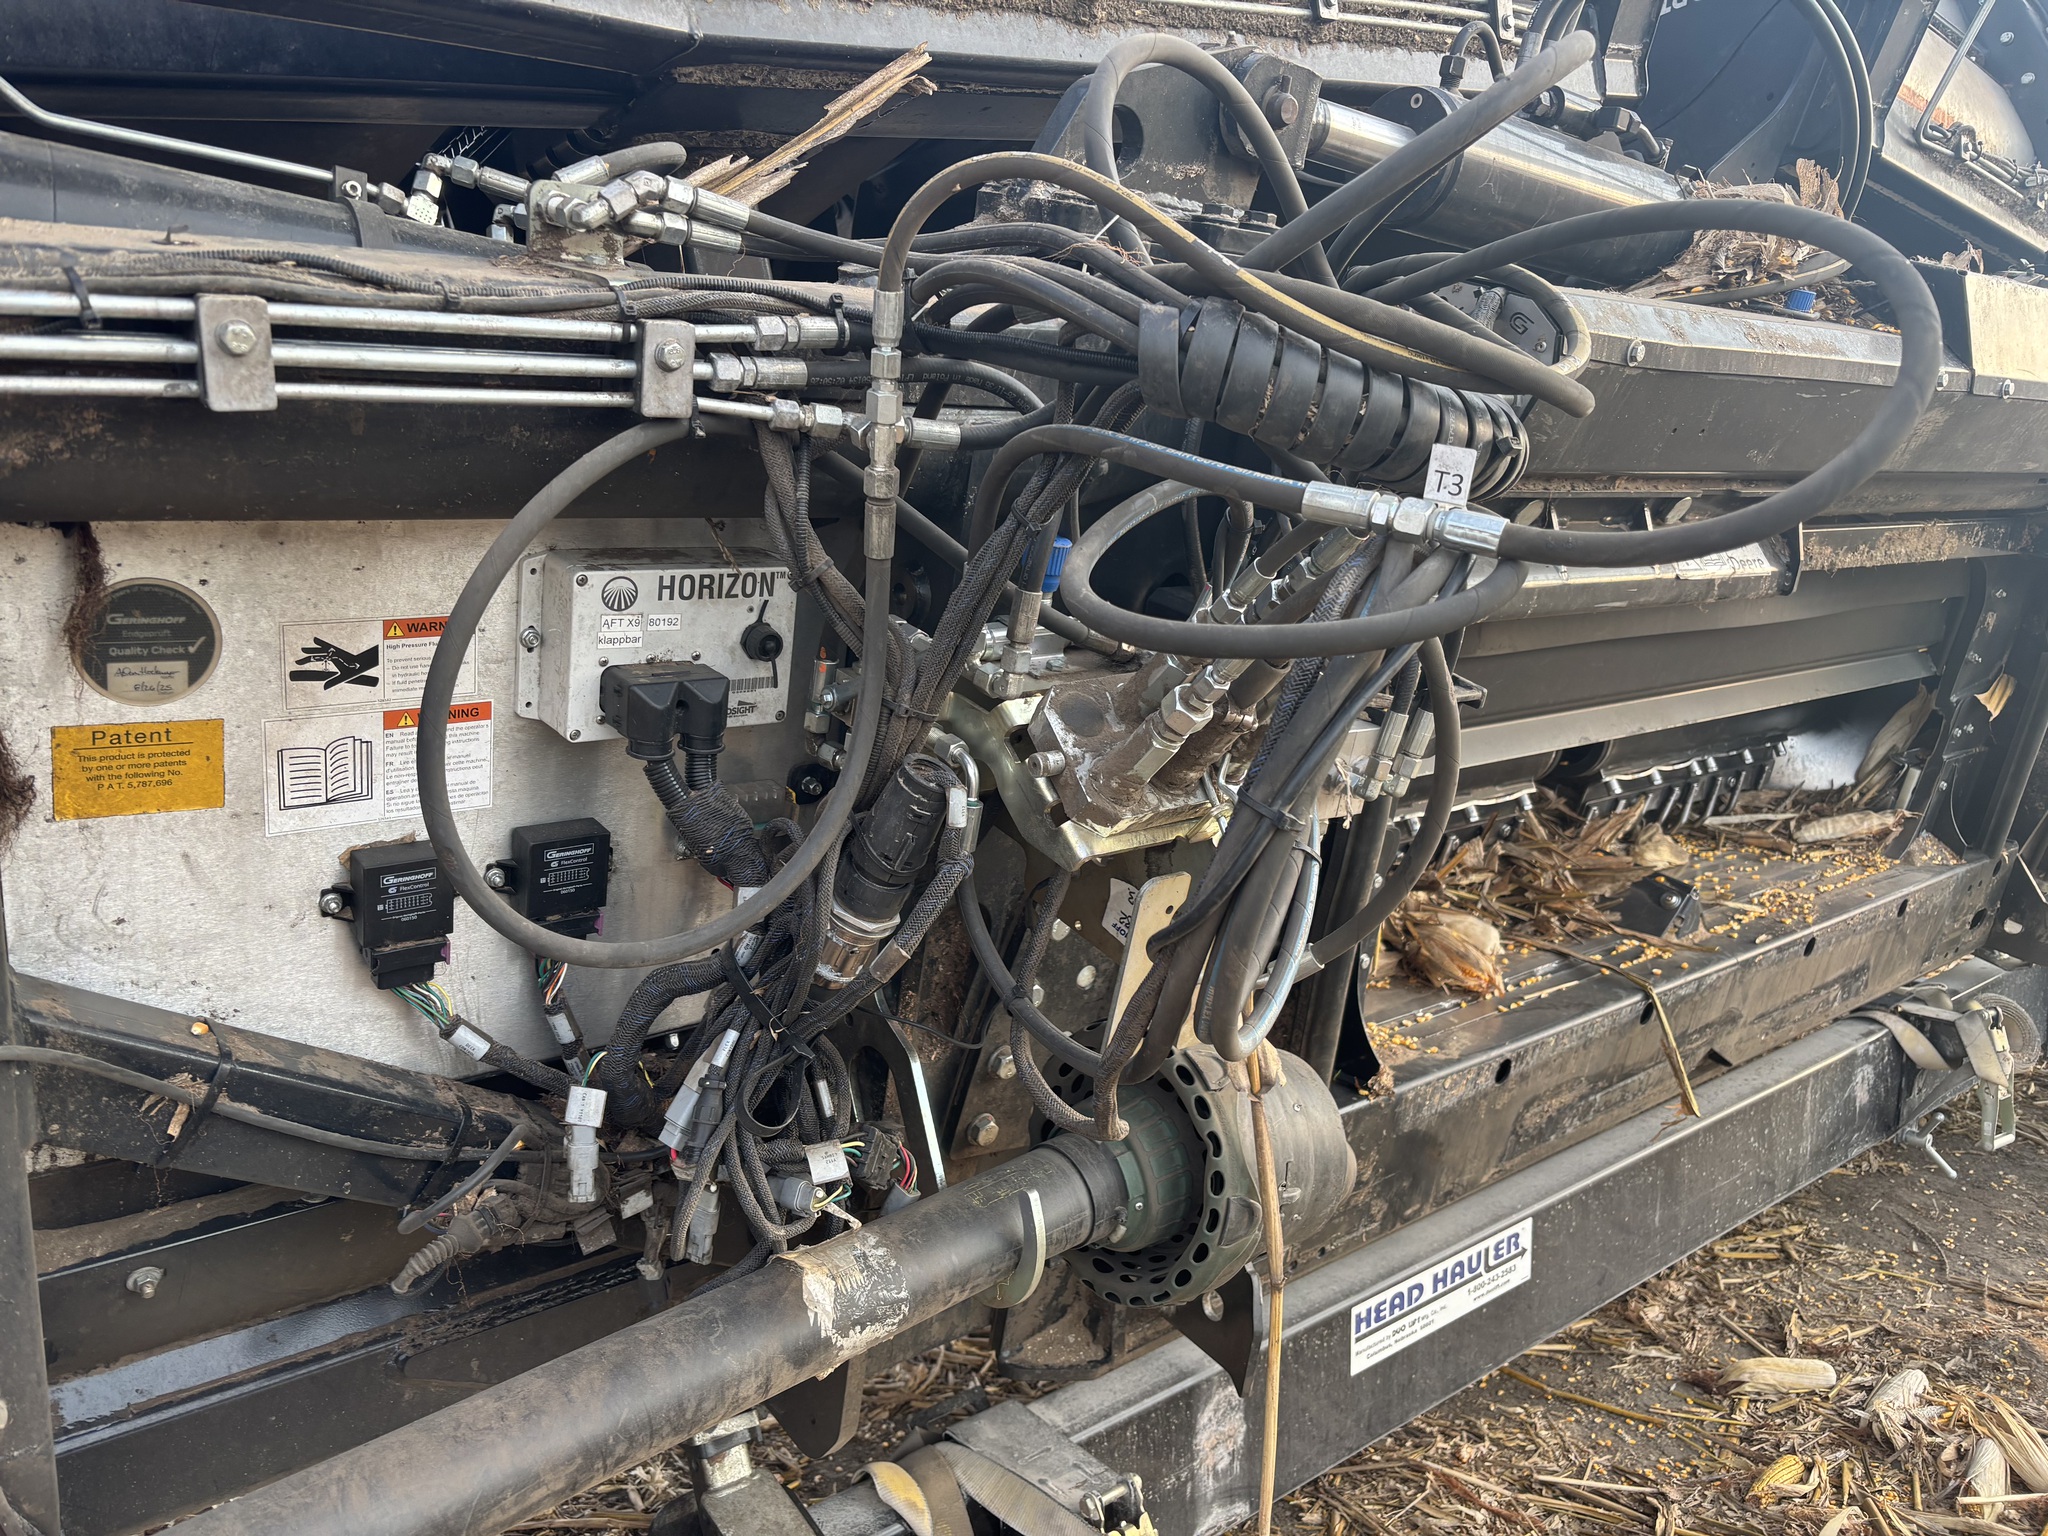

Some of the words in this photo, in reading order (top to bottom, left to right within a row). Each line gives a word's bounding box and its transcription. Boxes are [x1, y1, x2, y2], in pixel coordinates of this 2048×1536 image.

[1434, 469, 1464, 497] T3
[106, 613, 186, 625] GERINGHOFF
[602, 619, 624, 628] AFT
[627, 618, 640, 627] X9
[648, 618, 679, 626] 80192
[407, 621, 448, 632] WARN
[598, 636, 642, 646] klappbar
[109, 646, 149, 656] Quality
[151, 646, 185, 654] Check
[727, 704, 758, 715] DSIGHT
[91, 728, 173, 746] Patent
[78, 754, 97, 763] This
[99, 752, 135, 763] product
[148, 749, 191, 759] protected
[153, 759, 187, 769] patents
[86, 773, 105, 782] with
[108, 772, 122, 781] the
[124, 770, 165, 780] following
[127, 778, 173, 790] 5,787,696
[547, 847, 591, 858] GERINGHOFF
[561, 857, 587, 865] FlexControl
[383, 872, 433, 884] GERINGHOFF
[400, 882, 429, 891] FlexControl
[1355, 1282, 1424, 1335] HEAD
[1432, 1232, 1520, 1294] HAULER
[1392, 1324, 1406, 1337] DUO
